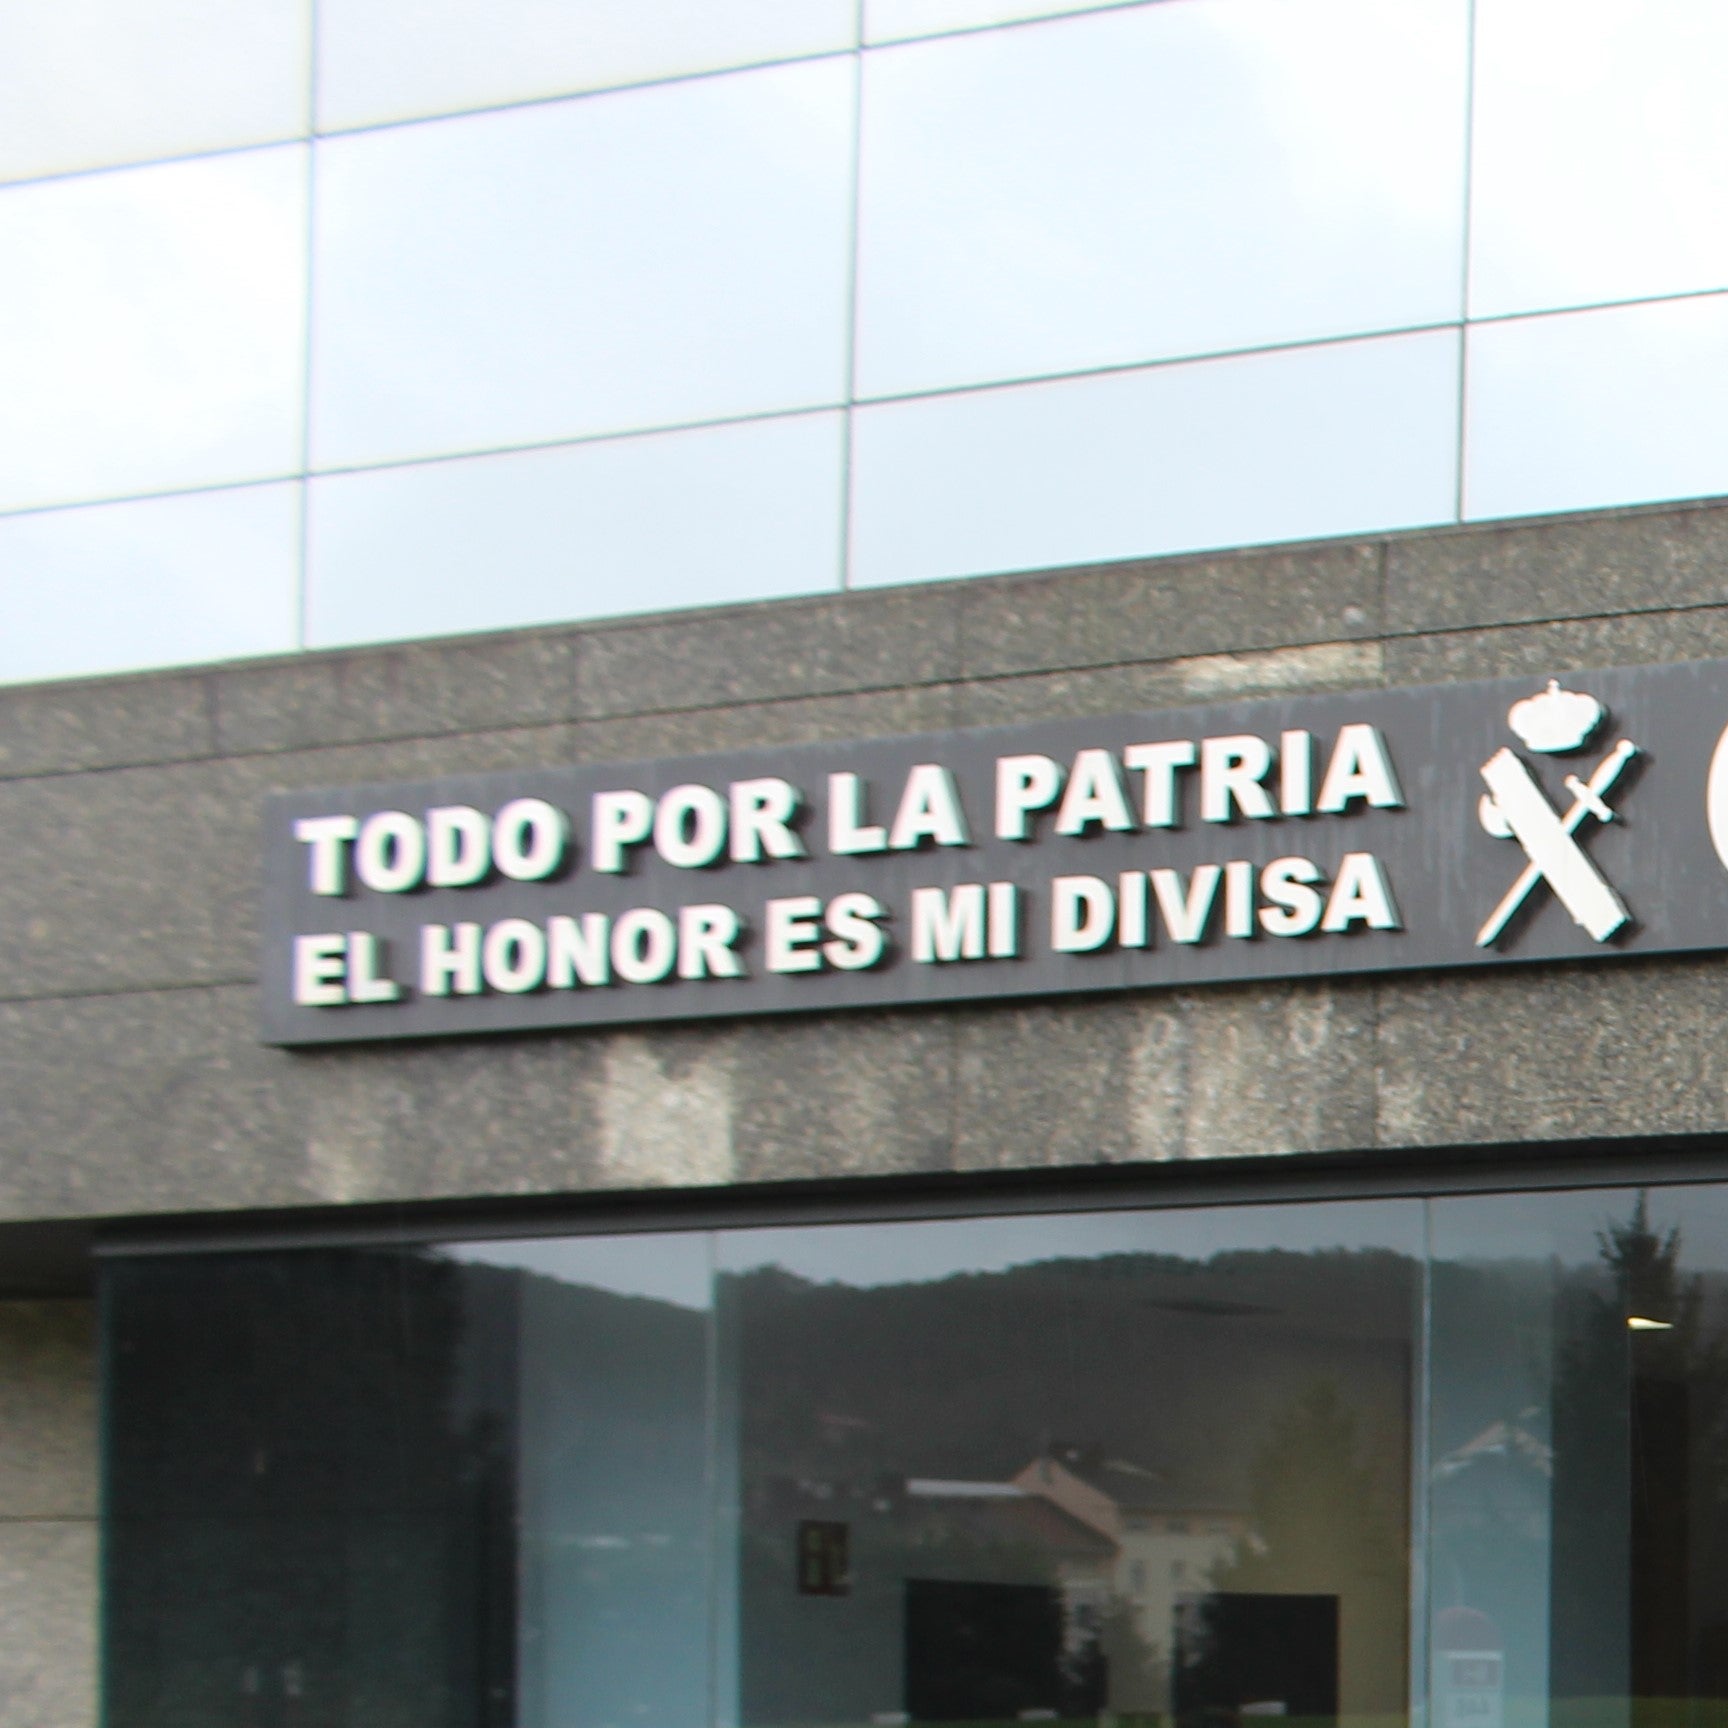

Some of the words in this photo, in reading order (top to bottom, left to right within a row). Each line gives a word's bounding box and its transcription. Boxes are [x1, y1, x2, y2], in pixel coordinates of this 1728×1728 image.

[295, 797, 562, 895] TODO
[592, 777, 799, 872] POR
[828, 764, 964, 854] LA
[995, 723, 1399, 839] PATRIA
[295, 931, 395, 1005] EL
[421, 904, 739, 996] HONOR
[766, 892, 883, 972] ES
[912, 881, 1015, 962] MI
[1052, 852, 1395, 951] DIVISA
